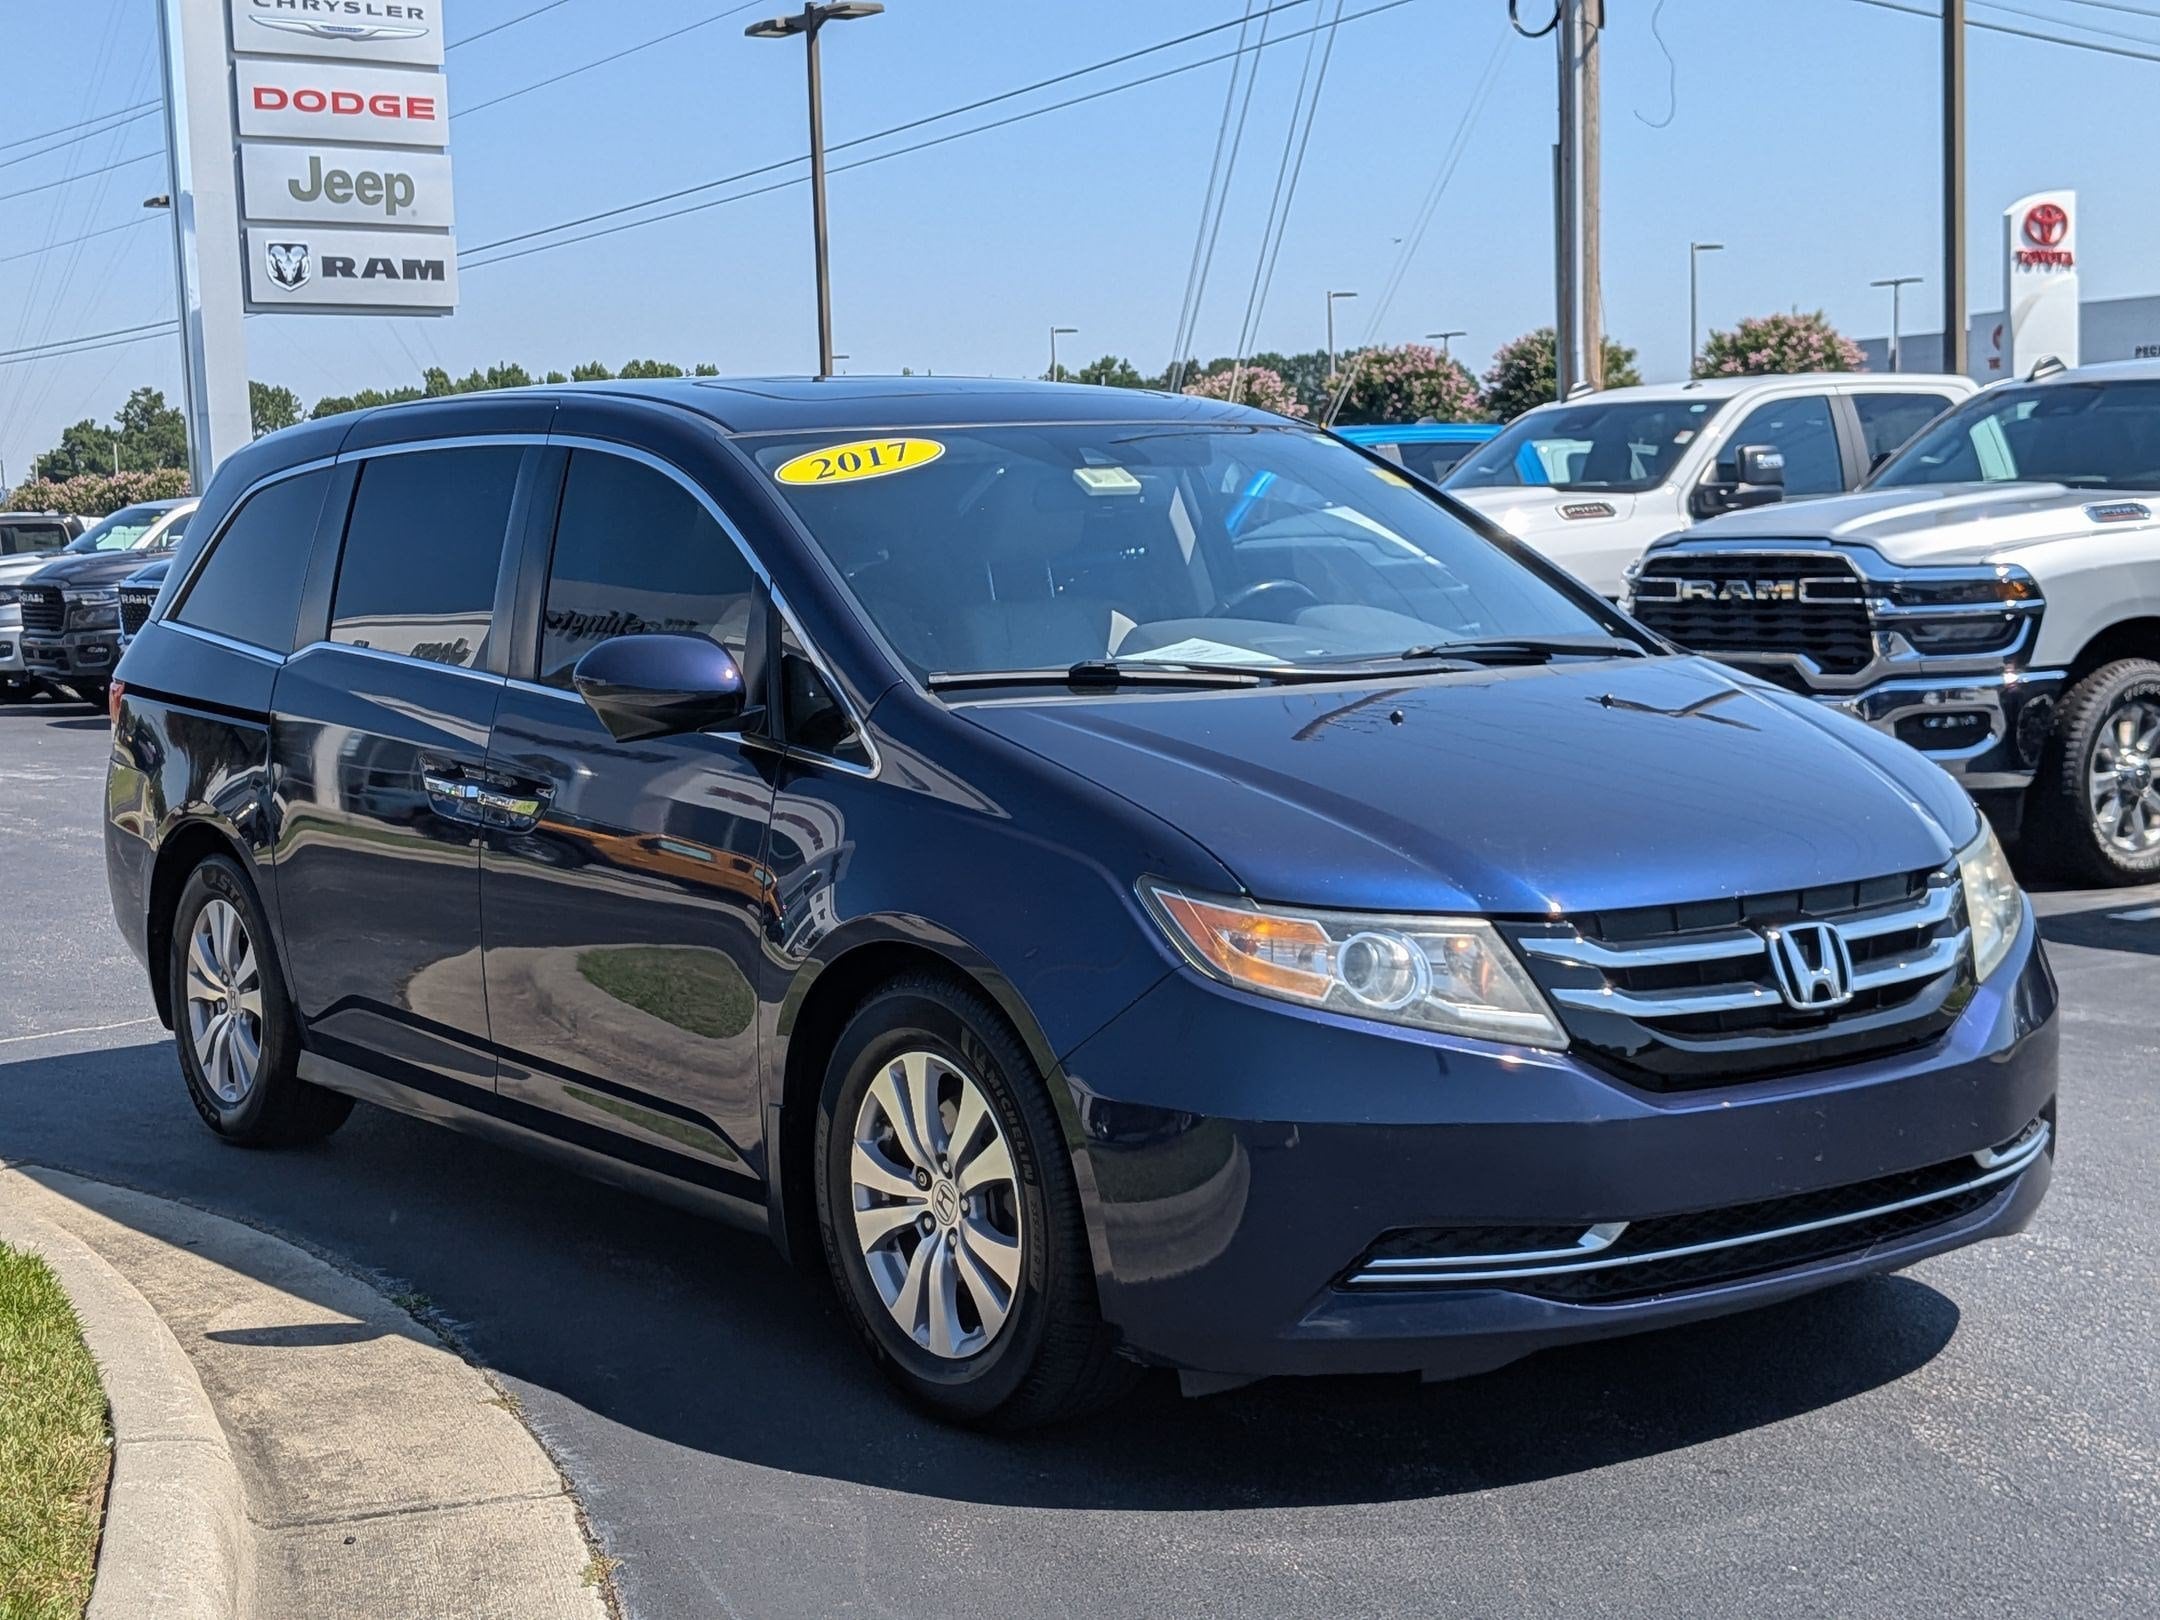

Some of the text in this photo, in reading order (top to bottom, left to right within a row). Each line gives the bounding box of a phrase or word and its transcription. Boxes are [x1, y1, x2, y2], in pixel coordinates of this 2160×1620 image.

[253, 0, 425, 19] CHRYSLER
[253, 87, 436, 120] DODGE
[288, 156, 416, 216] Jeep
[321, 255, 446, 281] RAM
[2015, 250, 2074, 266] TOYOTA
[2135, 345, 2160, 358] PEC
[809, 441, 907, 480] 2017
[1681, 579, 1796, 600] RAM
[986, 1071, 1036, 1182] MICHELIN
